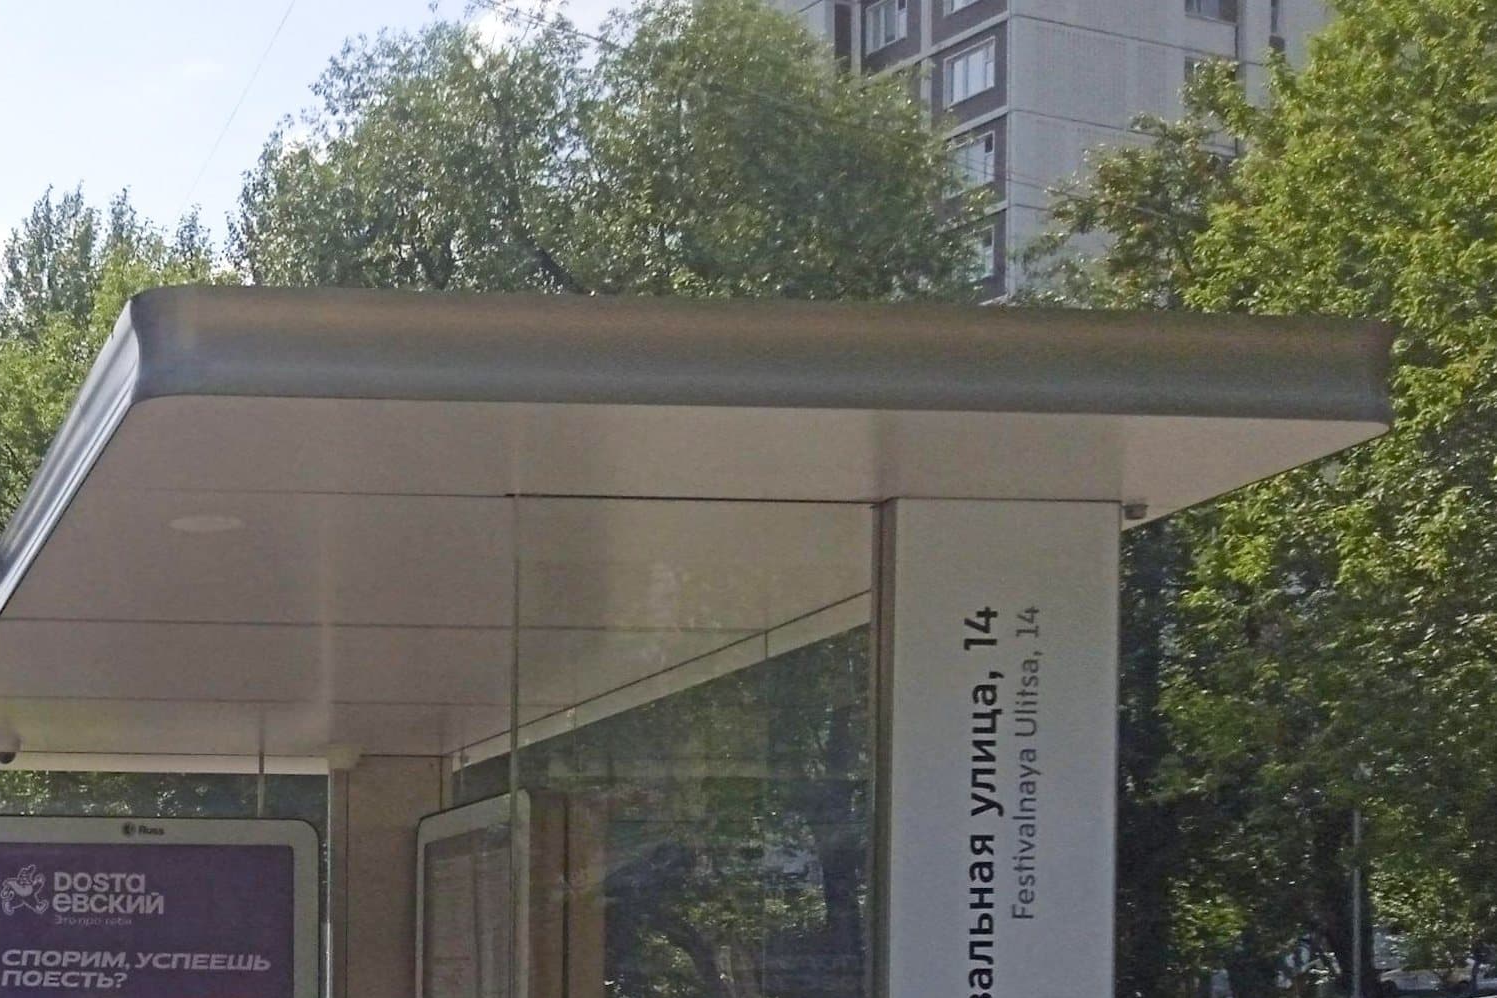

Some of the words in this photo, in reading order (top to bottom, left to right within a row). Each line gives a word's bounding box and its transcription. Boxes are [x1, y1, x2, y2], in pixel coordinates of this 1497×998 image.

[964, 606, 998, 651] 14
[1015, 606, 1040, 639] 14
[1014, 650, 1043, 739] Ulitsa,
[968, 671, 1005, 817] улица,
[1011, 748, 1040, 920] Festivalnaya
[1, 970, 128, 988] ПОЕСТЬ?
[2, 949, 130, 970] СПОРИМ,
[135, 952, 271, 971] УСПЕЕШЬ
